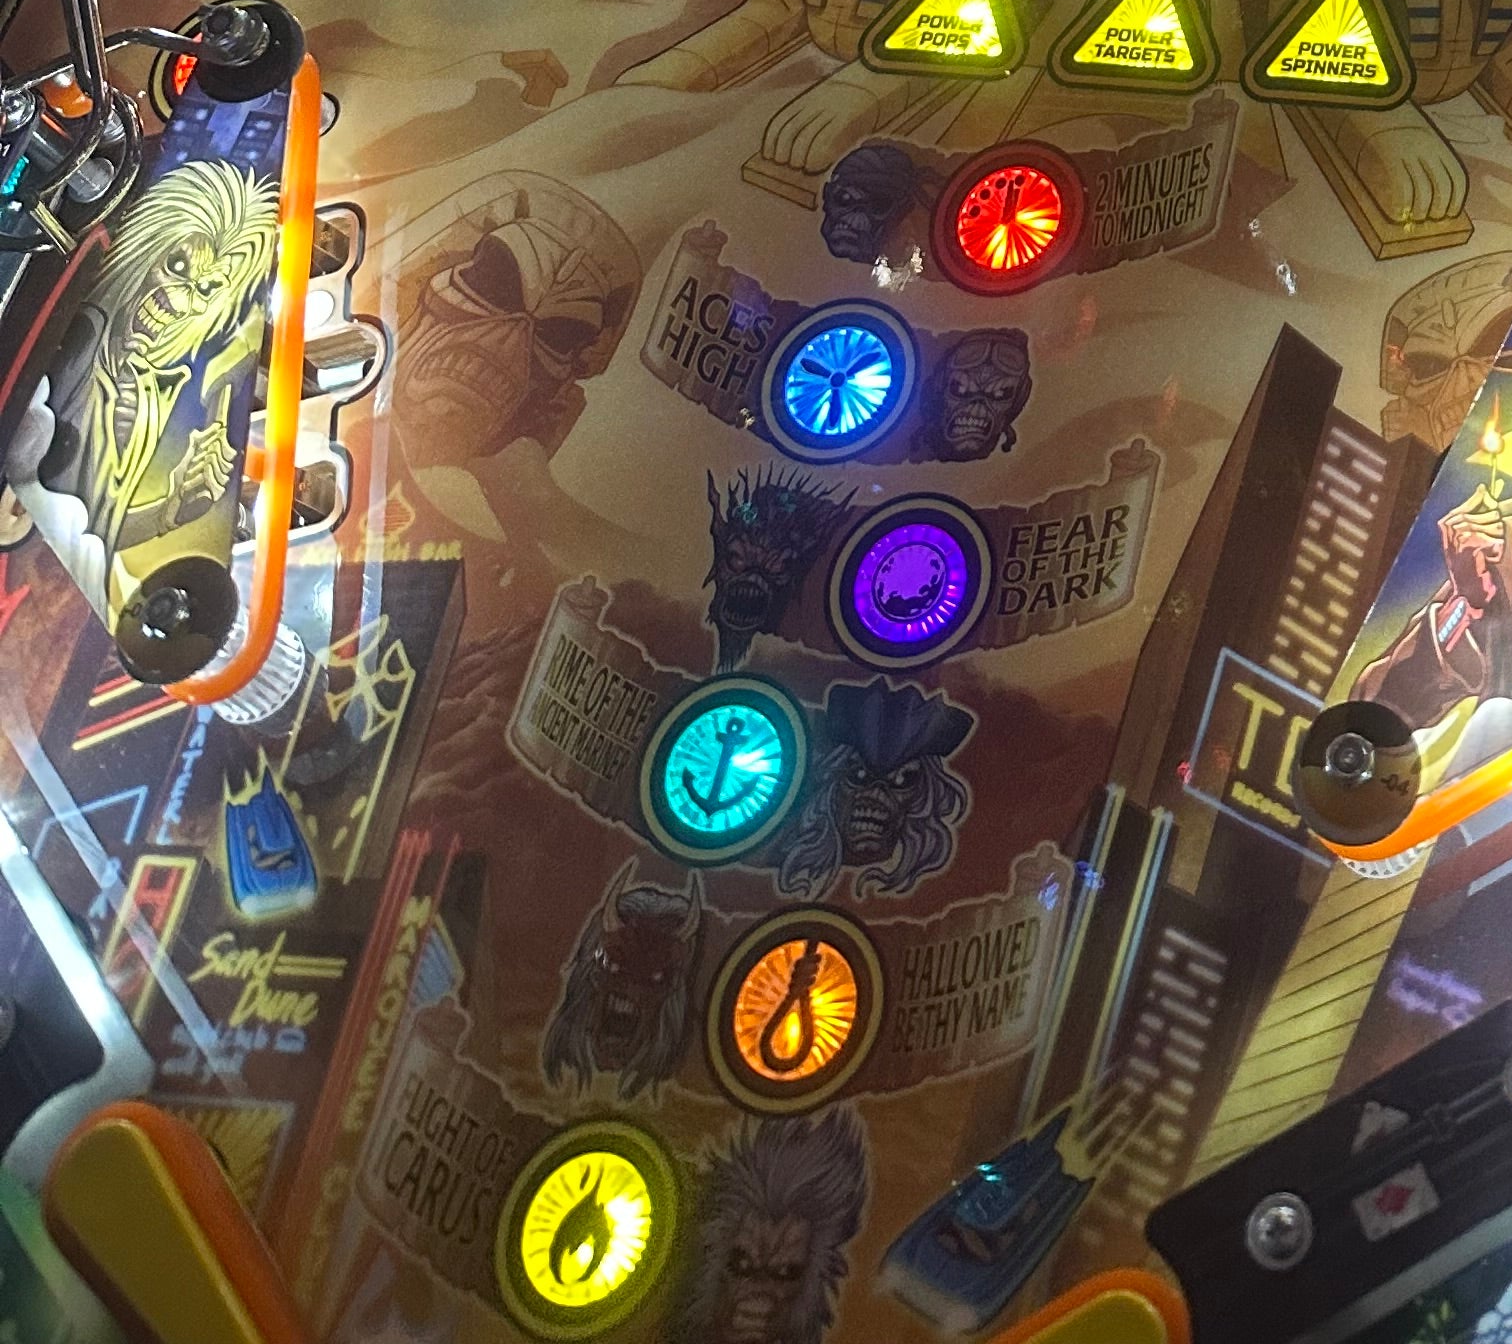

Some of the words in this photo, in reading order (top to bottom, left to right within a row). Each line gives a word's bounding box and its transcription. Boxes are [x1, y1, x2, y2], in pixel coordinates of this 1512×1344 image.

[916, 13, 983, 34] POWER
[918, 30, 970, 48] POPS
[1104, 27, 1174, 47] POWER
[1297, 41, 1367, 60] POWER
[1094, 43, 1176, 63] TARGETS
[1280, 58, 1378, 79] SPINNERS
[1095, 173, 1109, 212] 2
[1112, 142, 1214, 211] MINUTES
[1093, 214, 1114, 247] TO
[1117, 184, 1209, 244] MIDNIGHT
[669, 275, 775, 354] ACES
[657, 313, 758, 395] HIGH
[1002, 556, 1049, 583] OF
[1058, 533, 1129, 575] THE
[1006, 504, 1130, 559] FEAR
[997, 560, 1124, 615] DARK
[549, 633, 597, 708] RIME
[583, 666, 620, 722] OF
[607, 680, 657, 744] THE
[186, 930, 287, 984] Sand
[901, 916, 1041, 1001] HALLOWED
[891, 1004, 921, 1053] BE
[922, 994, 967, 1050] THY
[967, 973, 1031, 1038] NAME
[401, 1072, 480, 1161] FLIGHT
[474, 1132, 515, 1181] OF
[373, 1117, 492, 1244] ICARUS
